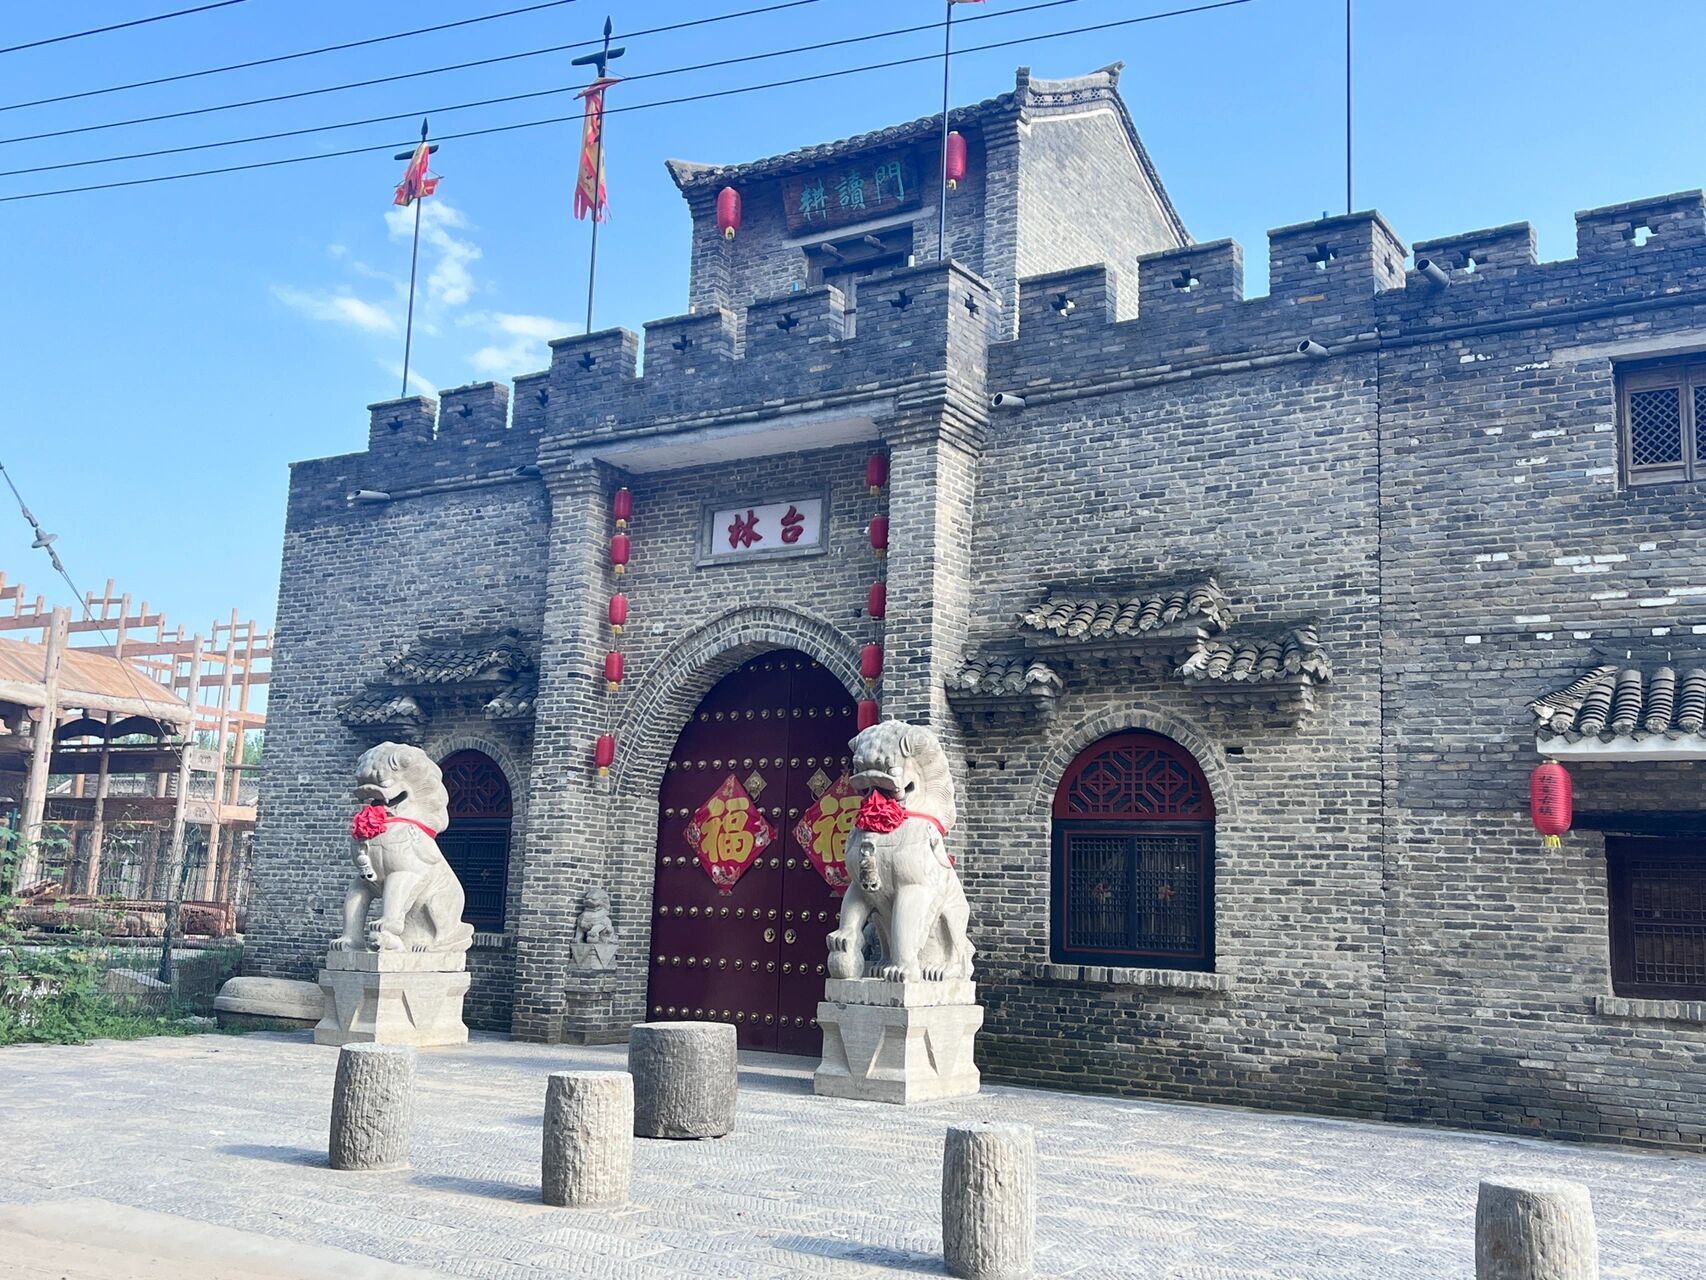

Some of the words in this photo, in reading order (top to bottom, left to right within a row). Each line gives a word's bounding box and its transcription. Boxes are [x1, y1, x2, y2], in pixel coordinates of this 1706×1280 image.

[799, 161, 905, 221] 耕讀門
[701, 796, 754, 863] 福
